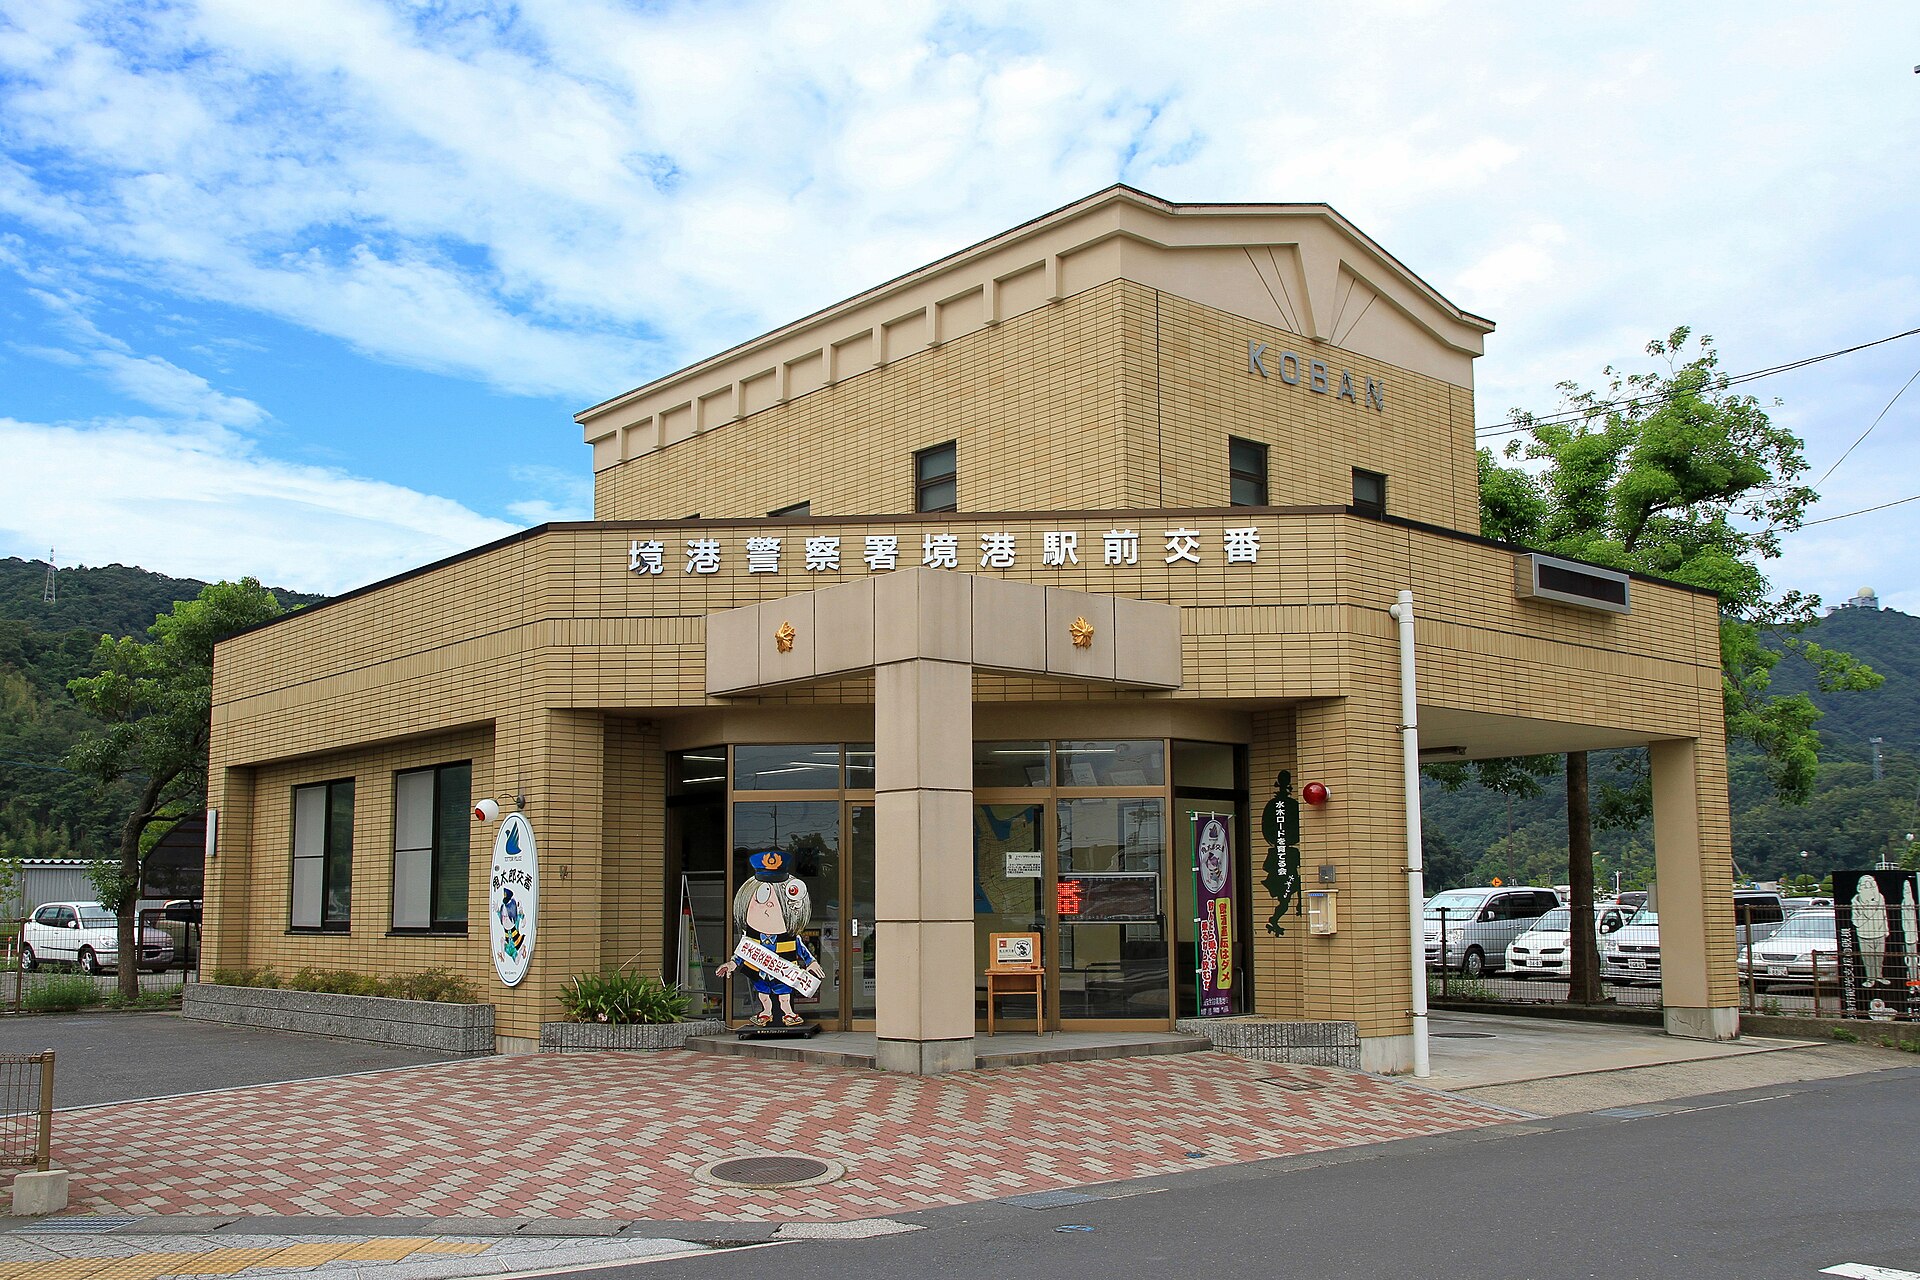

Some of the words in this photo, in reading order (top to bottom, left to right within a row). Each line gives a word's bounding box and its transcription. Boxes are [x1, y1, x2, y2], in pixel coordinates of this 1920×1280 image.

[1248, 340, 1384, 411] KOBAN
[629, 527, 1261, 576] 境港警察署境港駅前交番
[1275, 800, 1288, 876] 水木ロードを育てる会
[492, 868, 533, 892] 鬼太郎交番
[740, 941, 813, 992] 鬼太郎交番防犯パトロール中
